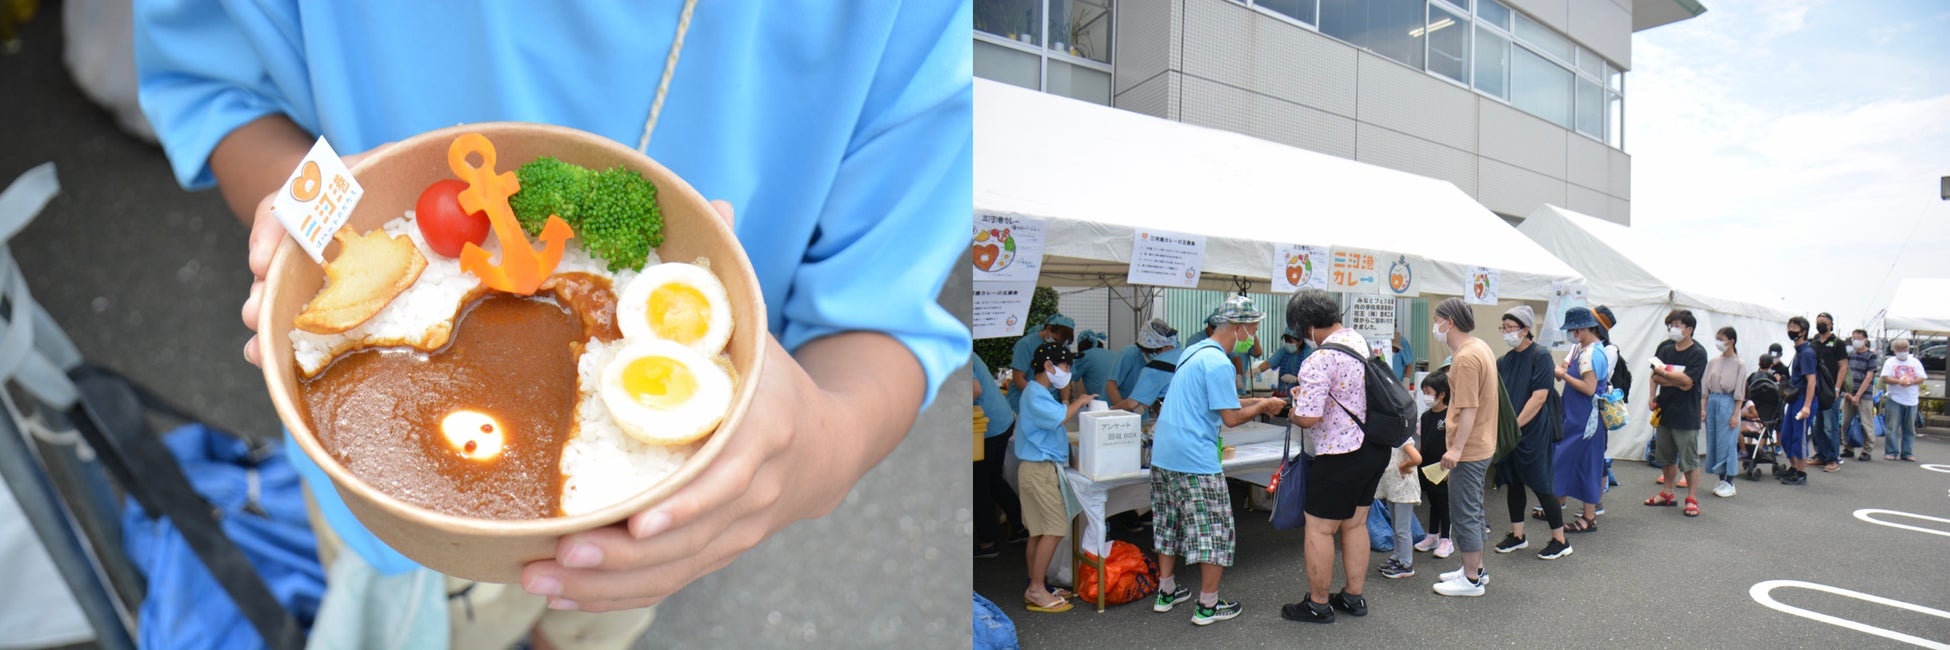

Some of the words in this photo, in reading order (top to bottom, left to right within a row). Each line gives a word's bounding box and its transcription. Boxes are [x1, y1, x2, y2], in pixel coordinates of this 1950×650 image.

[300, 174, 351, 243] 三河港
[316, 190, 357, 249] はハートのかたち
[1334, 252, 1374, 270] 三河港
[1334, 270, 1374, 286] カレー
[1101, 422, 1131, 430] アンケート
